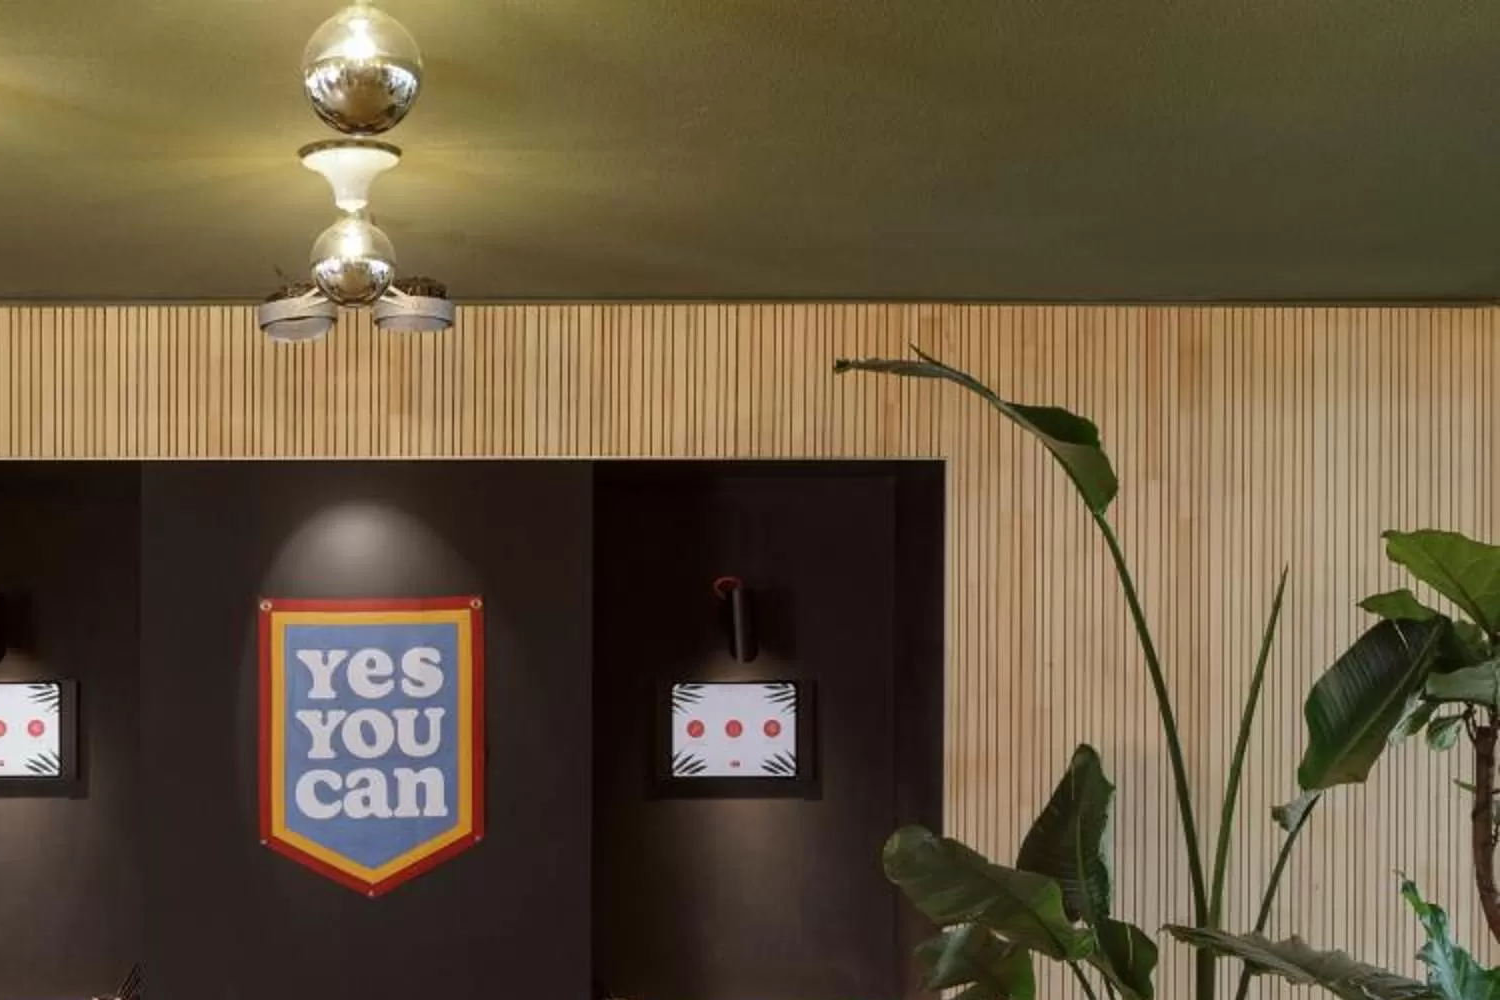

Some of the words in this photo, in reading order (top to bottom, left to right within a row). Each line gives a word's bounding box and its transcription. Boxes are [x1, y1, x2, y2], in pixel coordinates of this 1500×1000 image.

[296, 647, 445, 699] Yes
[296, 707, 446, 759] YOU
[295, 766, 449, 820] can
